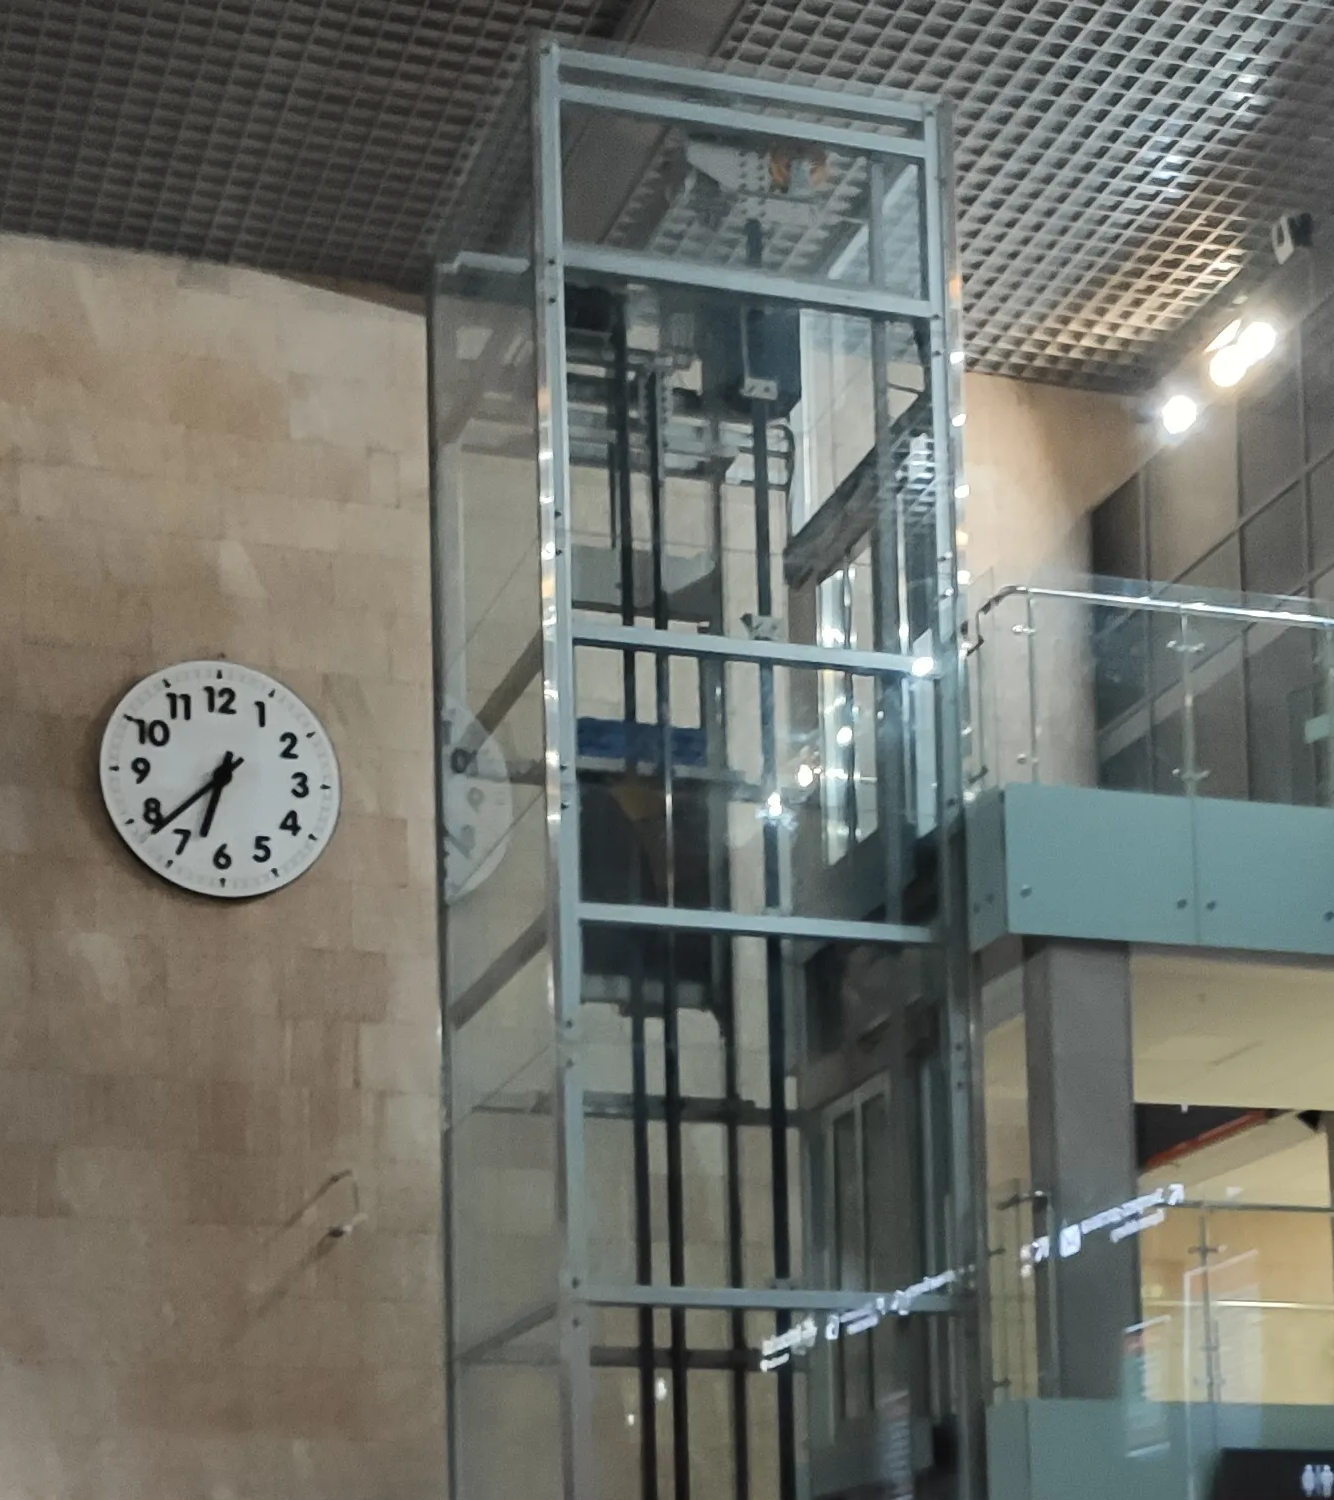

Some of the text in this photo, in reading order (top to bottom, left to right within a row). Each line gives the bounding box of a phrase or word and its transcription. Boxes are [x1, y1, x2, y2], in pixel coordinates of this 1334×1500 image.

[166, 692, 191, 720] 11
[204, 686, 236, 714] 12
[254, 700, 266, 728] 1
[132, 717, 170, 747] 10
[279, 732, 299, 759] 2
[131, 757, 151, 784] 9
[291, 772, 309, 798] 3
[143, 798, 163, 828] 8
[279, 810, 301, 836] 4
[173, 828, 191, 855] 7
[252, 836, 271, 863] 5
[213, 843, 231, 870] 6
